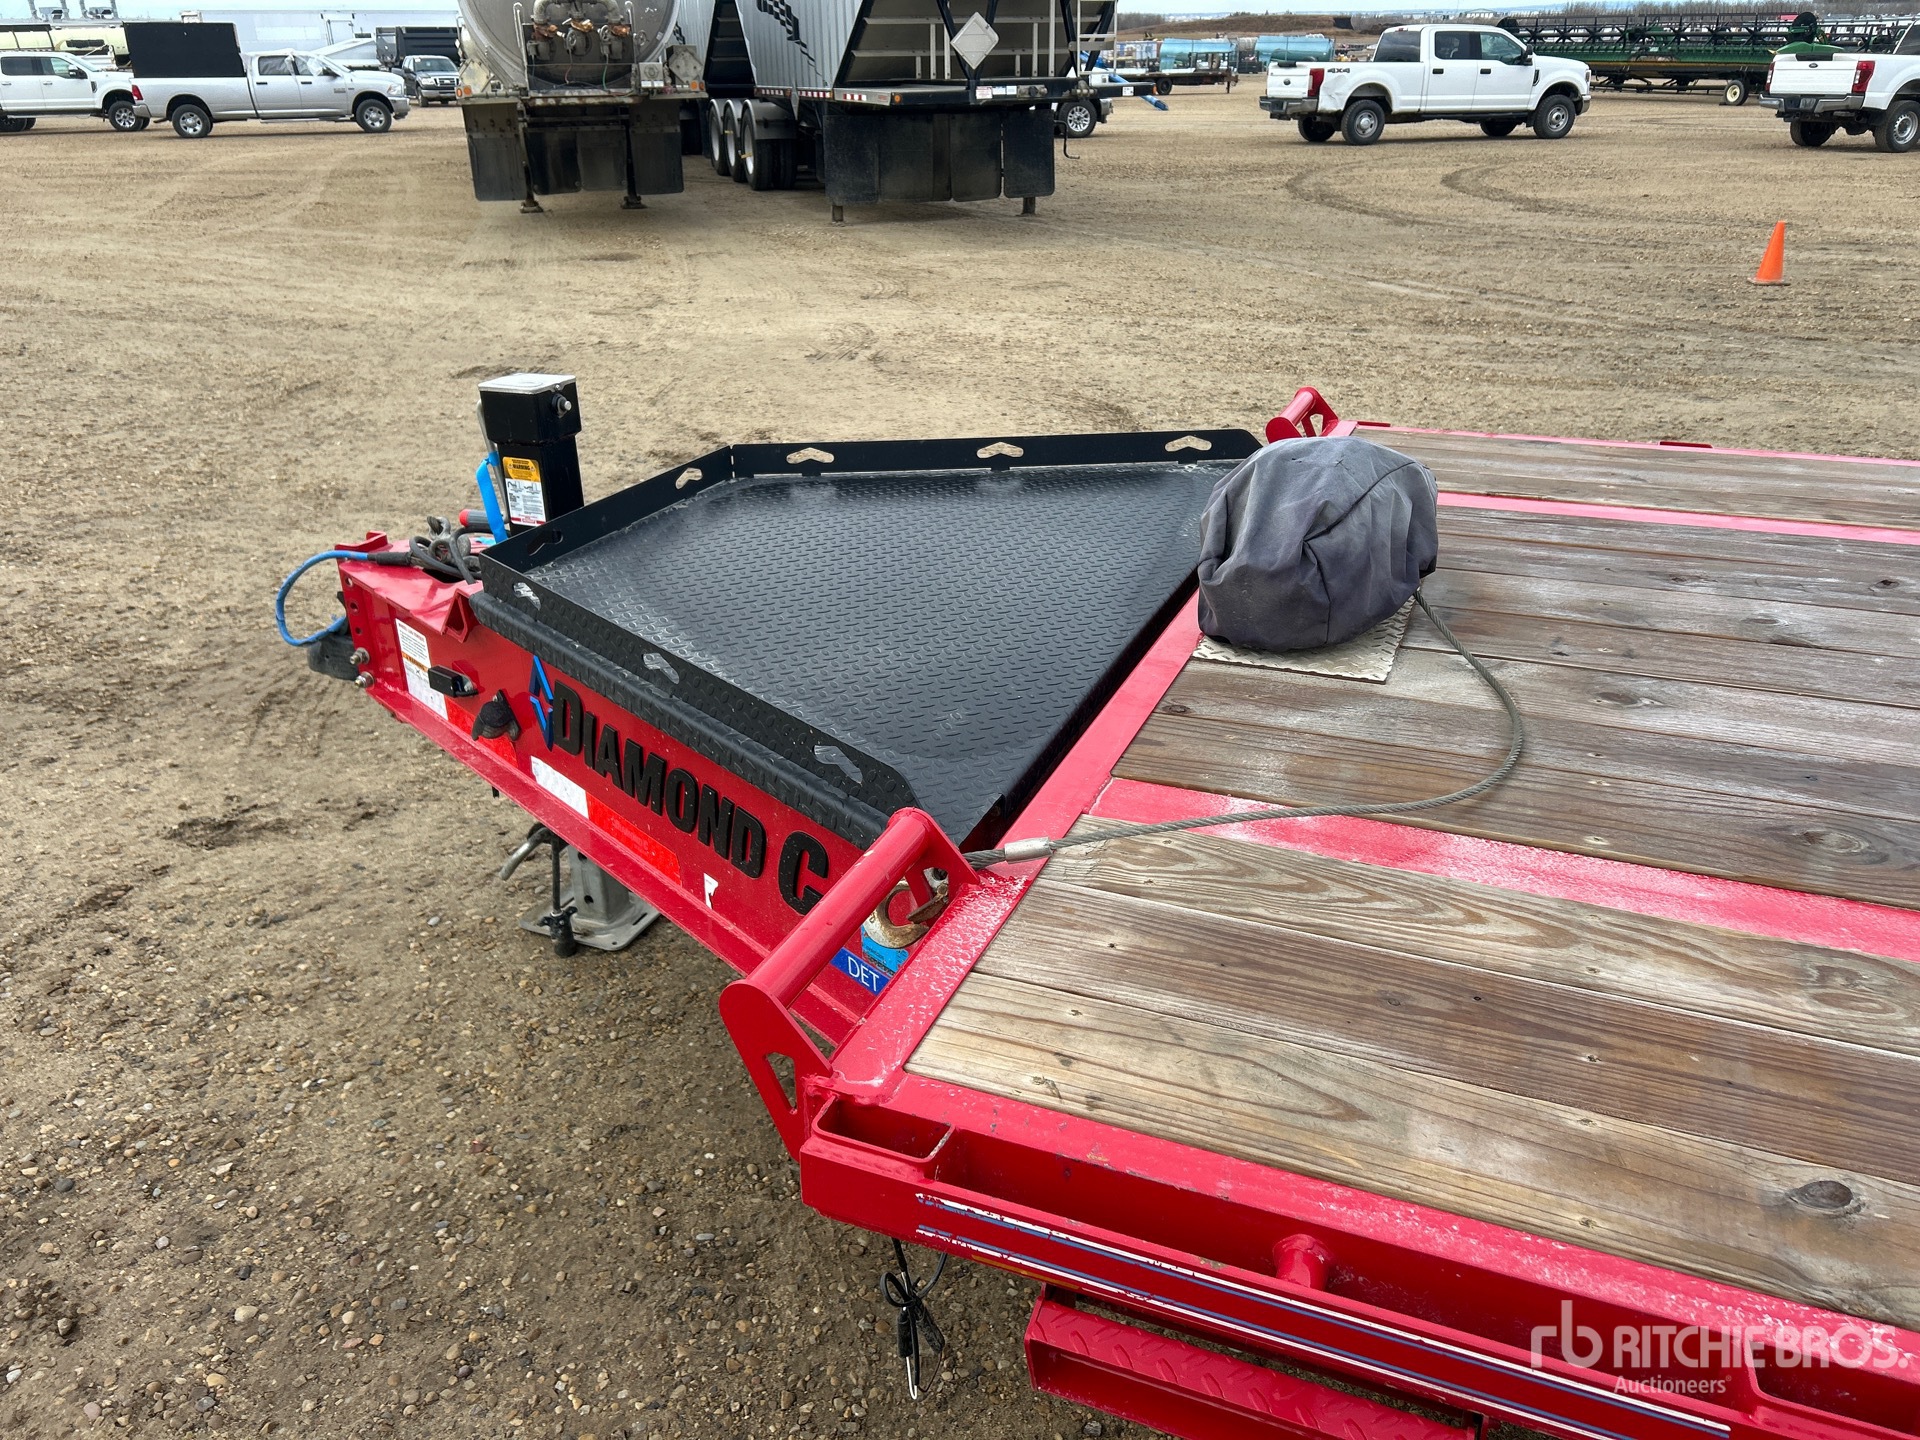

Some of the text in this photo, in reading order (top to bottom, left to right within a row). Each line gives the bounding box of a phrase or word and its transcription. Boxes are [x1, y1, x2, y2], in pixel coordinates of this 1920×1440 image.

[553, 680, 830, 916] DIAMOND C
[847, 955, 880, 992] DET
